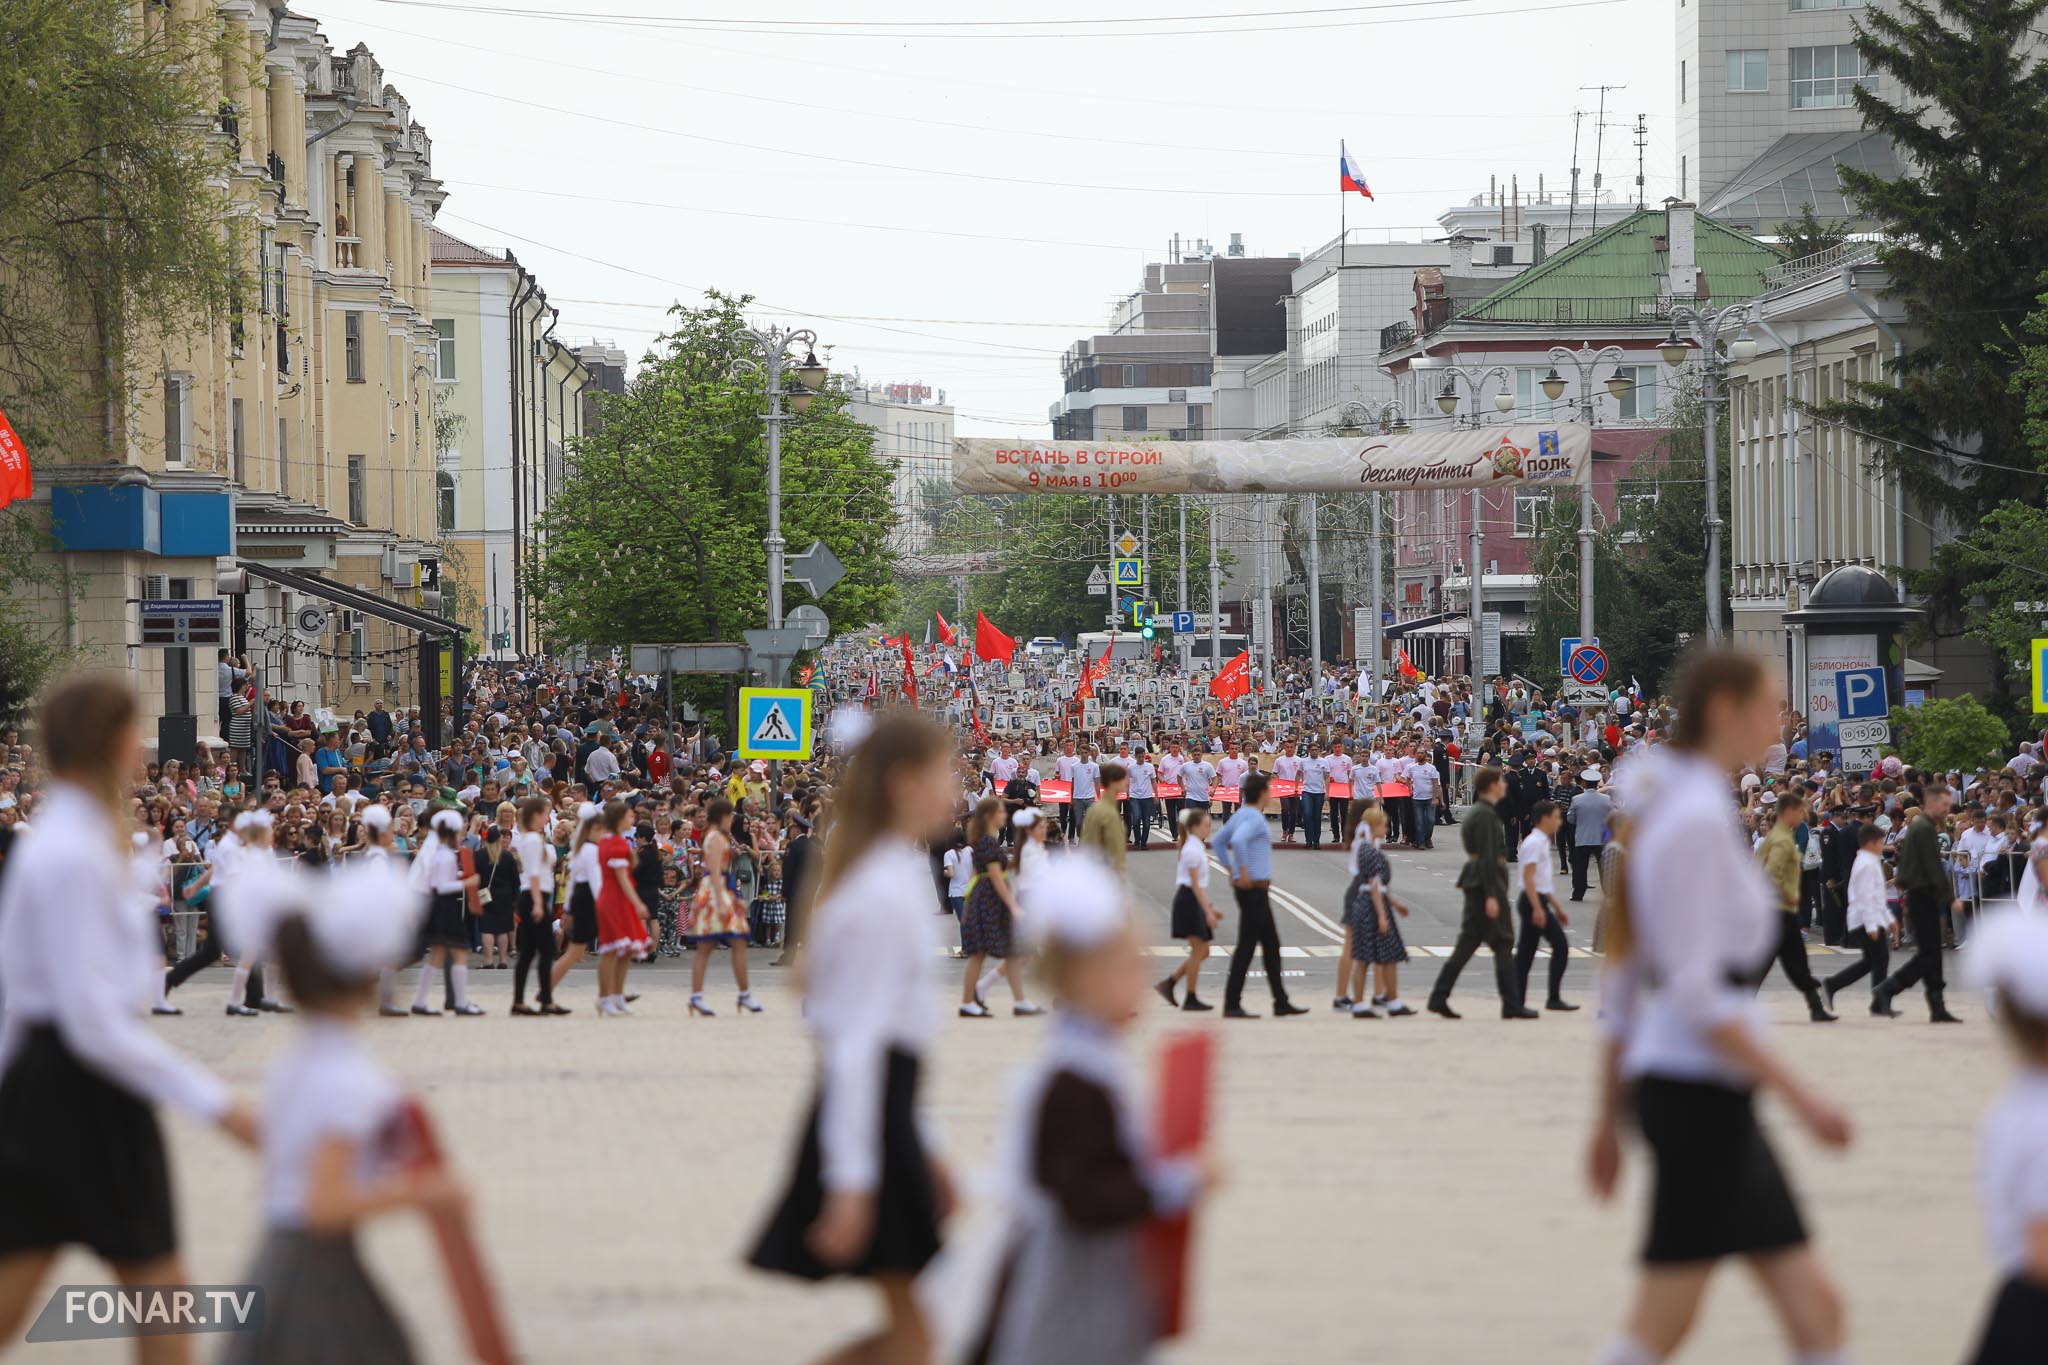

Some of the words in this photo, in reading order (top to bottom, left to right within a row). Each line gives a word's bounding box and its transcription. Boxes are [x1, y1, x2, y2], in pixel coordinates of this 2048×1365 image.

[996, 450, 1070, 464] ВСТАНЬ
[1076, 450, 1088, 464] В
[1094, 449, 1163, 465] СТРОЙ!
[1527, 457, 1571, 472] ПОЛК
[1028, 472, 1040, 487] 9
[1046, 476, 1078, 487] МАЯ
[1083, 476, 1091, 487] В
[1527, 470, 1572, 480] БЕЛГОРОД
[1809, 661, 1871, 671] БИБЛИОНОЧЬ
[1817, 678, 1836, 687] АПРЕ
[1844, 673, 1875, 715] P
[1856, 730, 1866, 738] 15
[1870, 727, 1882, 737] 20
